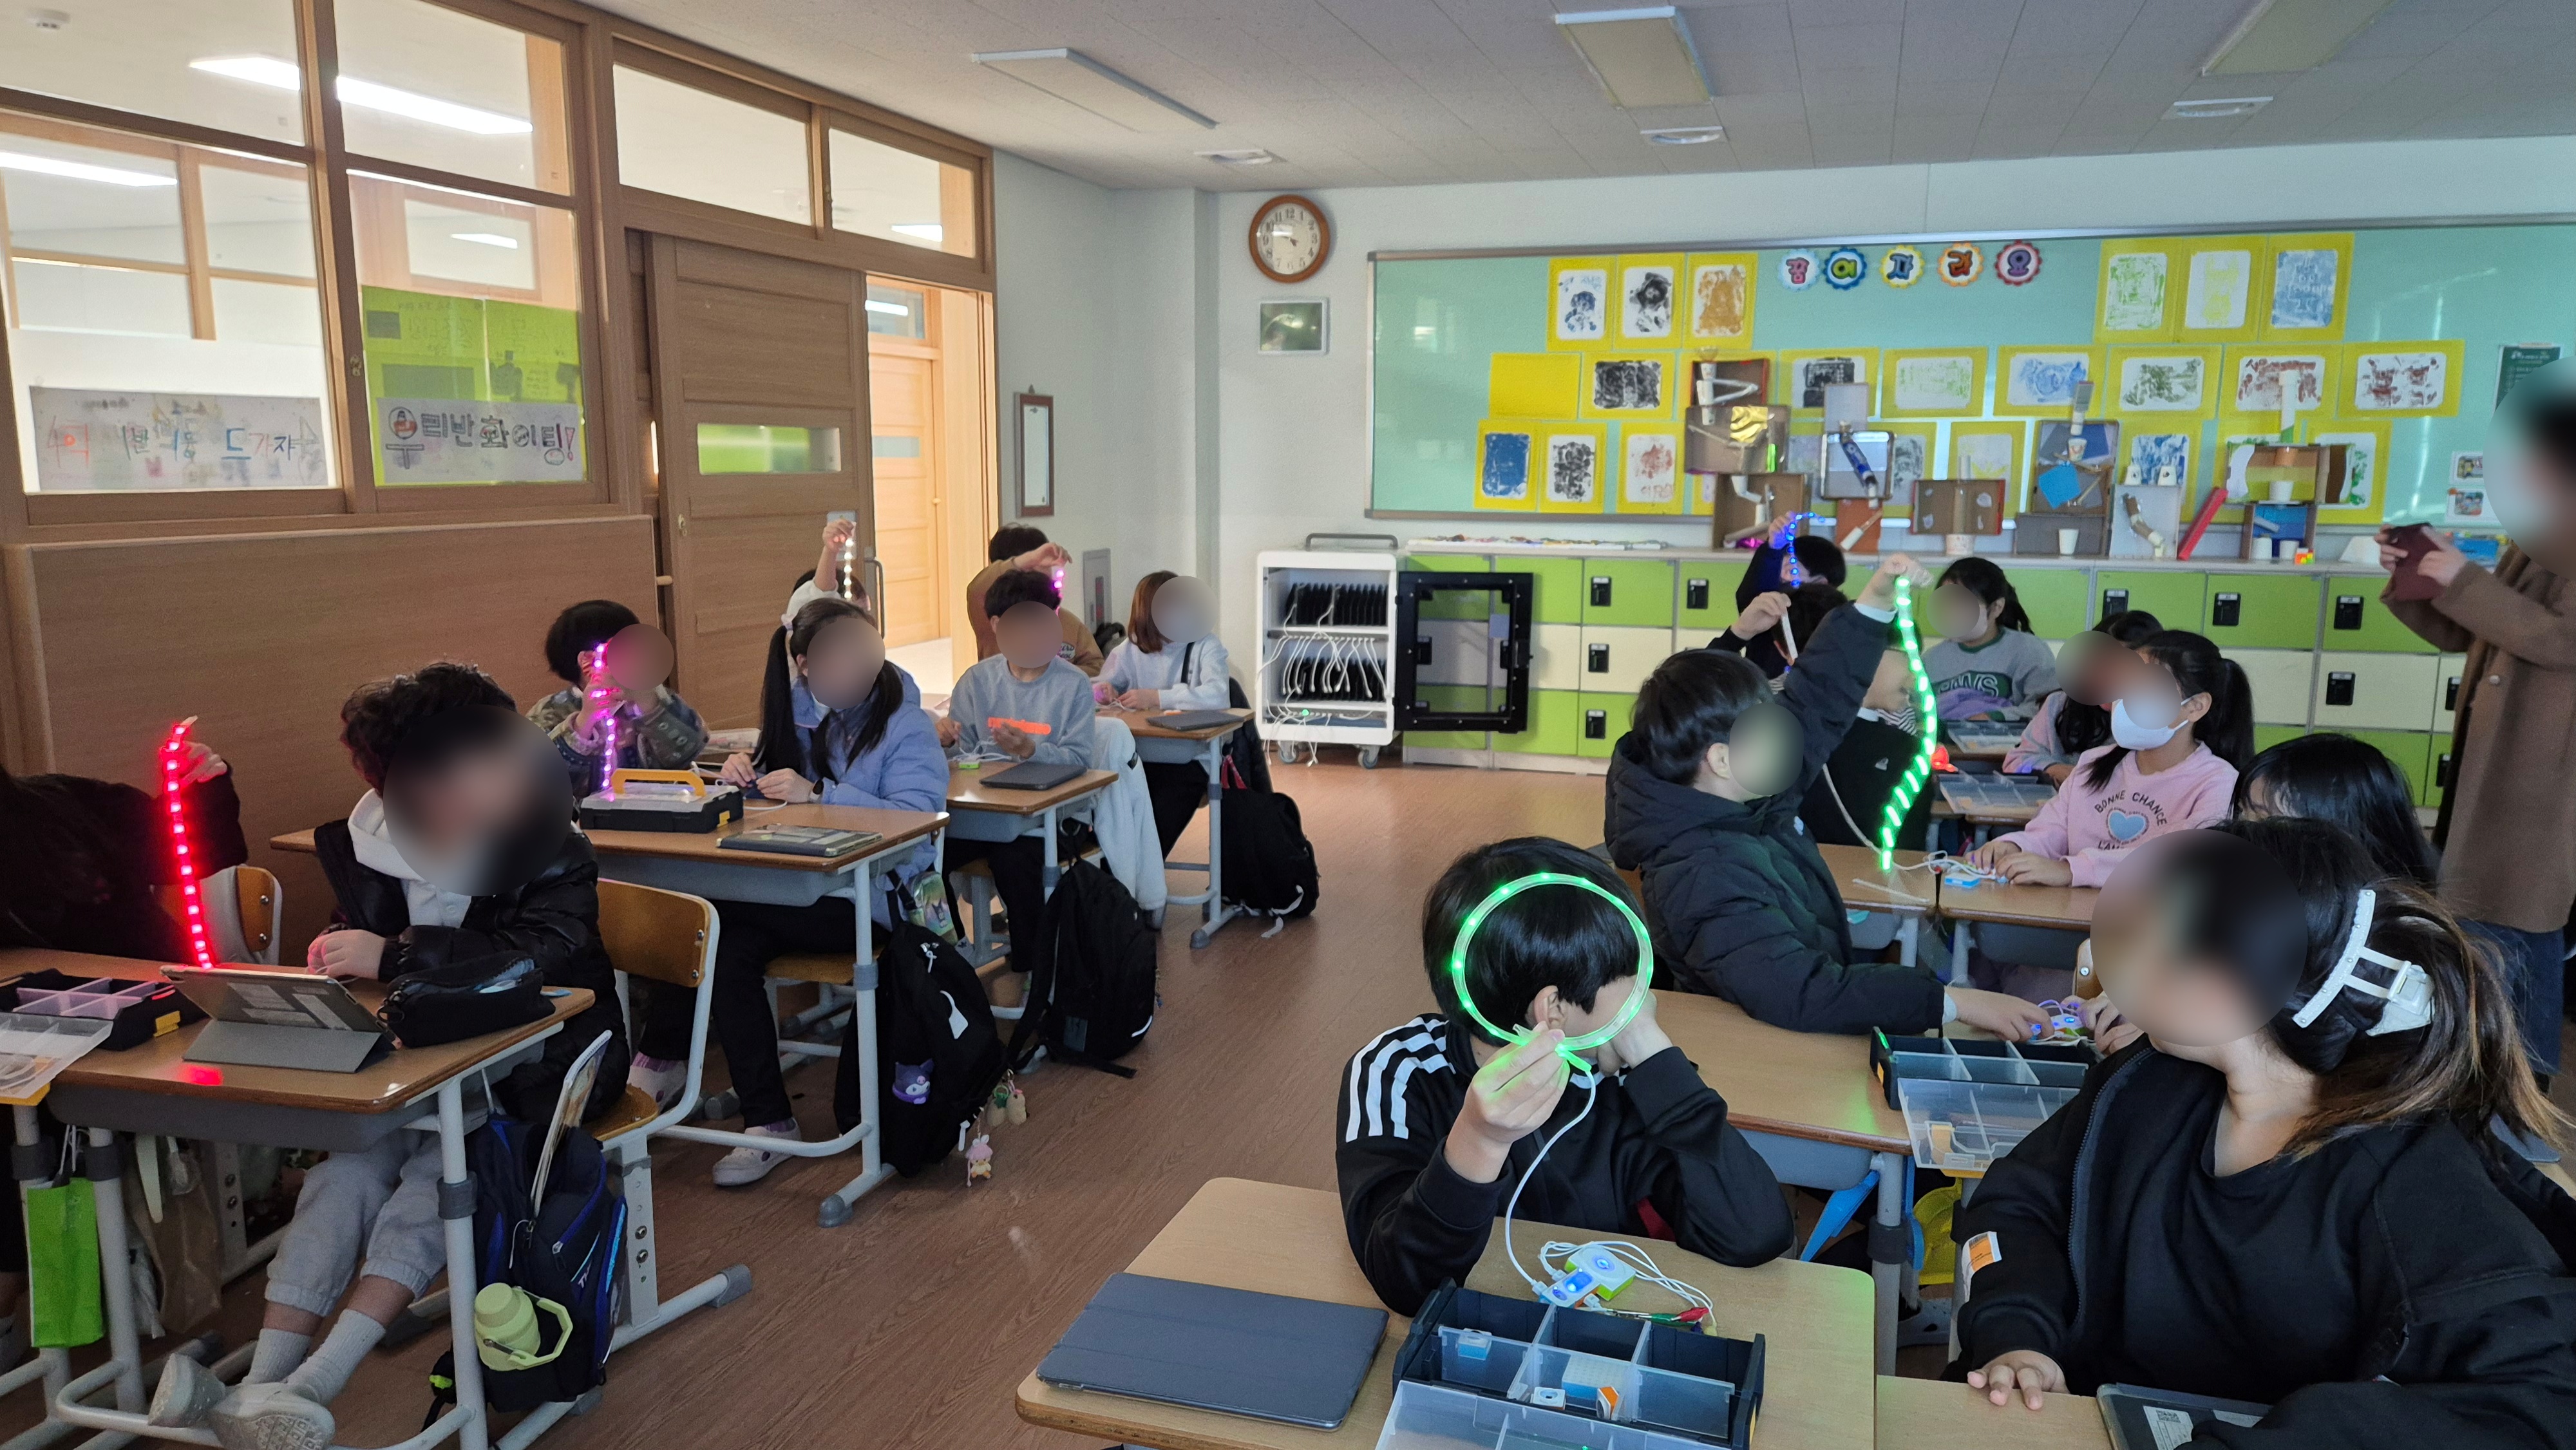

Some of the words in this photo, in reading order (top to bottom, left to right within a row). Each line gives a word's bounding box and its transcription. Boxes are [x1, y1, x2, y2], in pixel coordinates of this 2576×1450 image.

[1274, 212, 1282, 222] 11
[1285, 208, 1295, 219] 12
[1299, 210, 1304, 220] 1
[1308, 220, 1315, 231] 2
[1263, 235, 1269, 246] 9
[1311, 232, 1318, 244] 3
[1266, 249, 1273, 259] 8
[1307, 247, 1314, 257] 4
[1276, 258, 1282, 268] 7
[1287, 261, 1294, 270] 6
[1299, 257, 1306, 267] 5
[2094, 790, 2126, 813] BONNE
[2132, 791, 2168, 826] CHANCE
